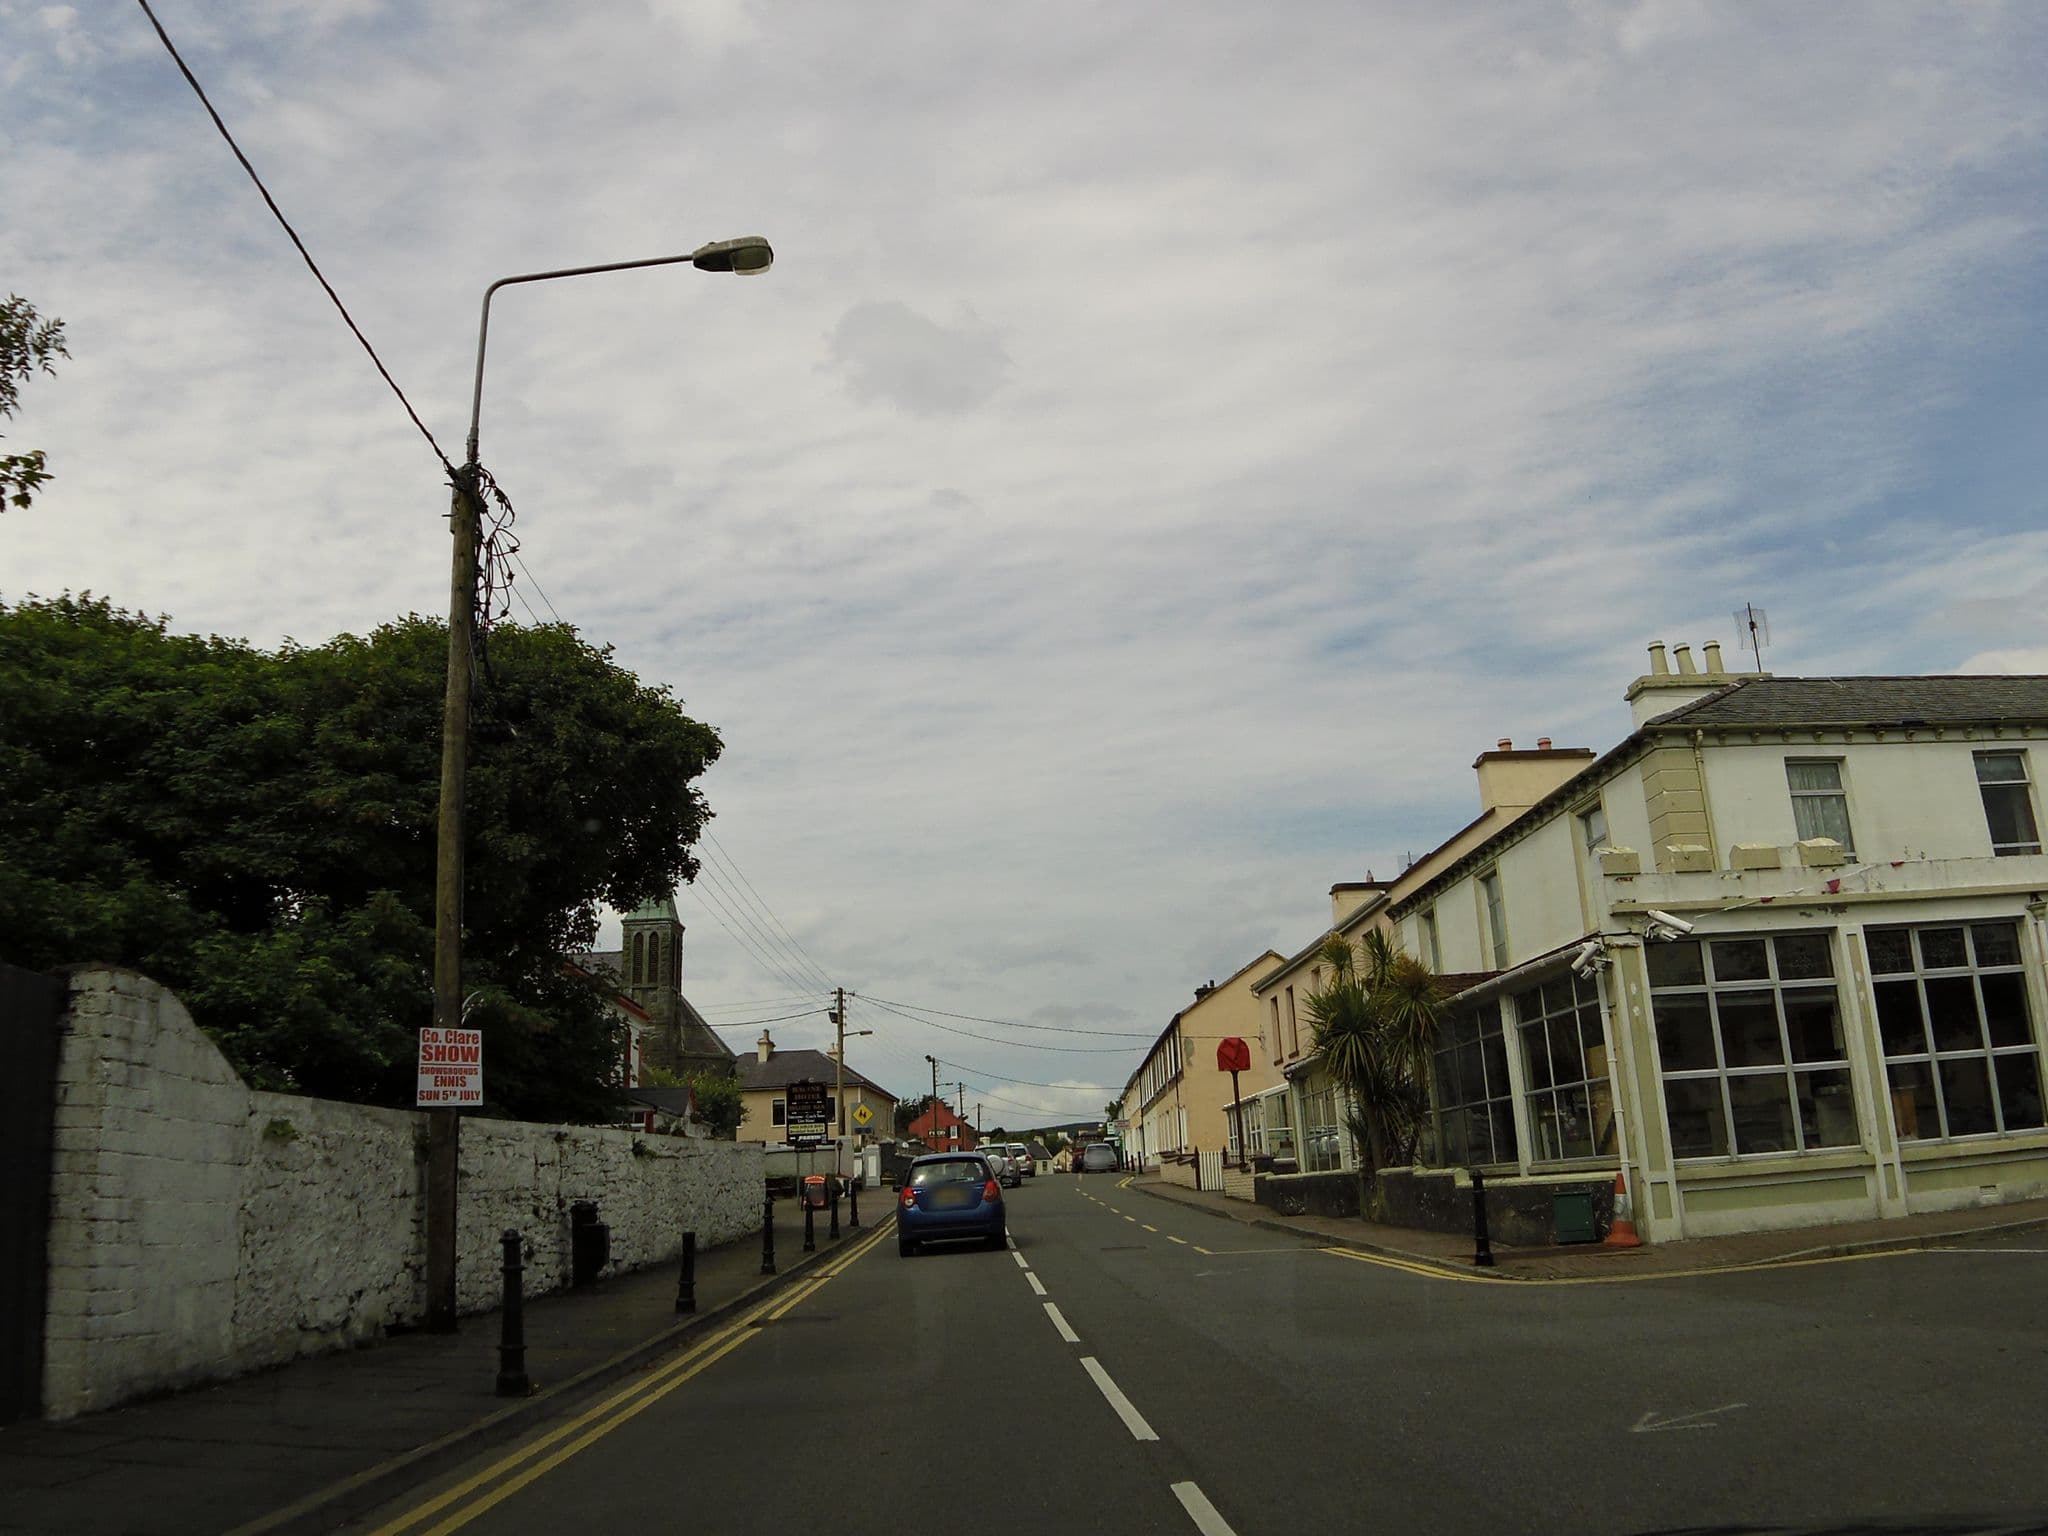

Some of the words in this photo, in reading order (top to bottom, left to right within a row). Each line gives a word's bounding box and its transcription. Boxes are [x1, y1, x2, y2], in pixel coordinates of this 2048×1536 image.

[421, 1028, 442, 1043] Co.
[445, 1030, 480, 1045] Clare
[421, 1044, 480, 1062] SHOW
[420, 1066, 478, 1075] SHOWGROUNDS
[434, 1075, 467, 1087] ENNIS
[419, 1090, 440, 1101] SUN
[459, 1090, 480, 1101] JULY
